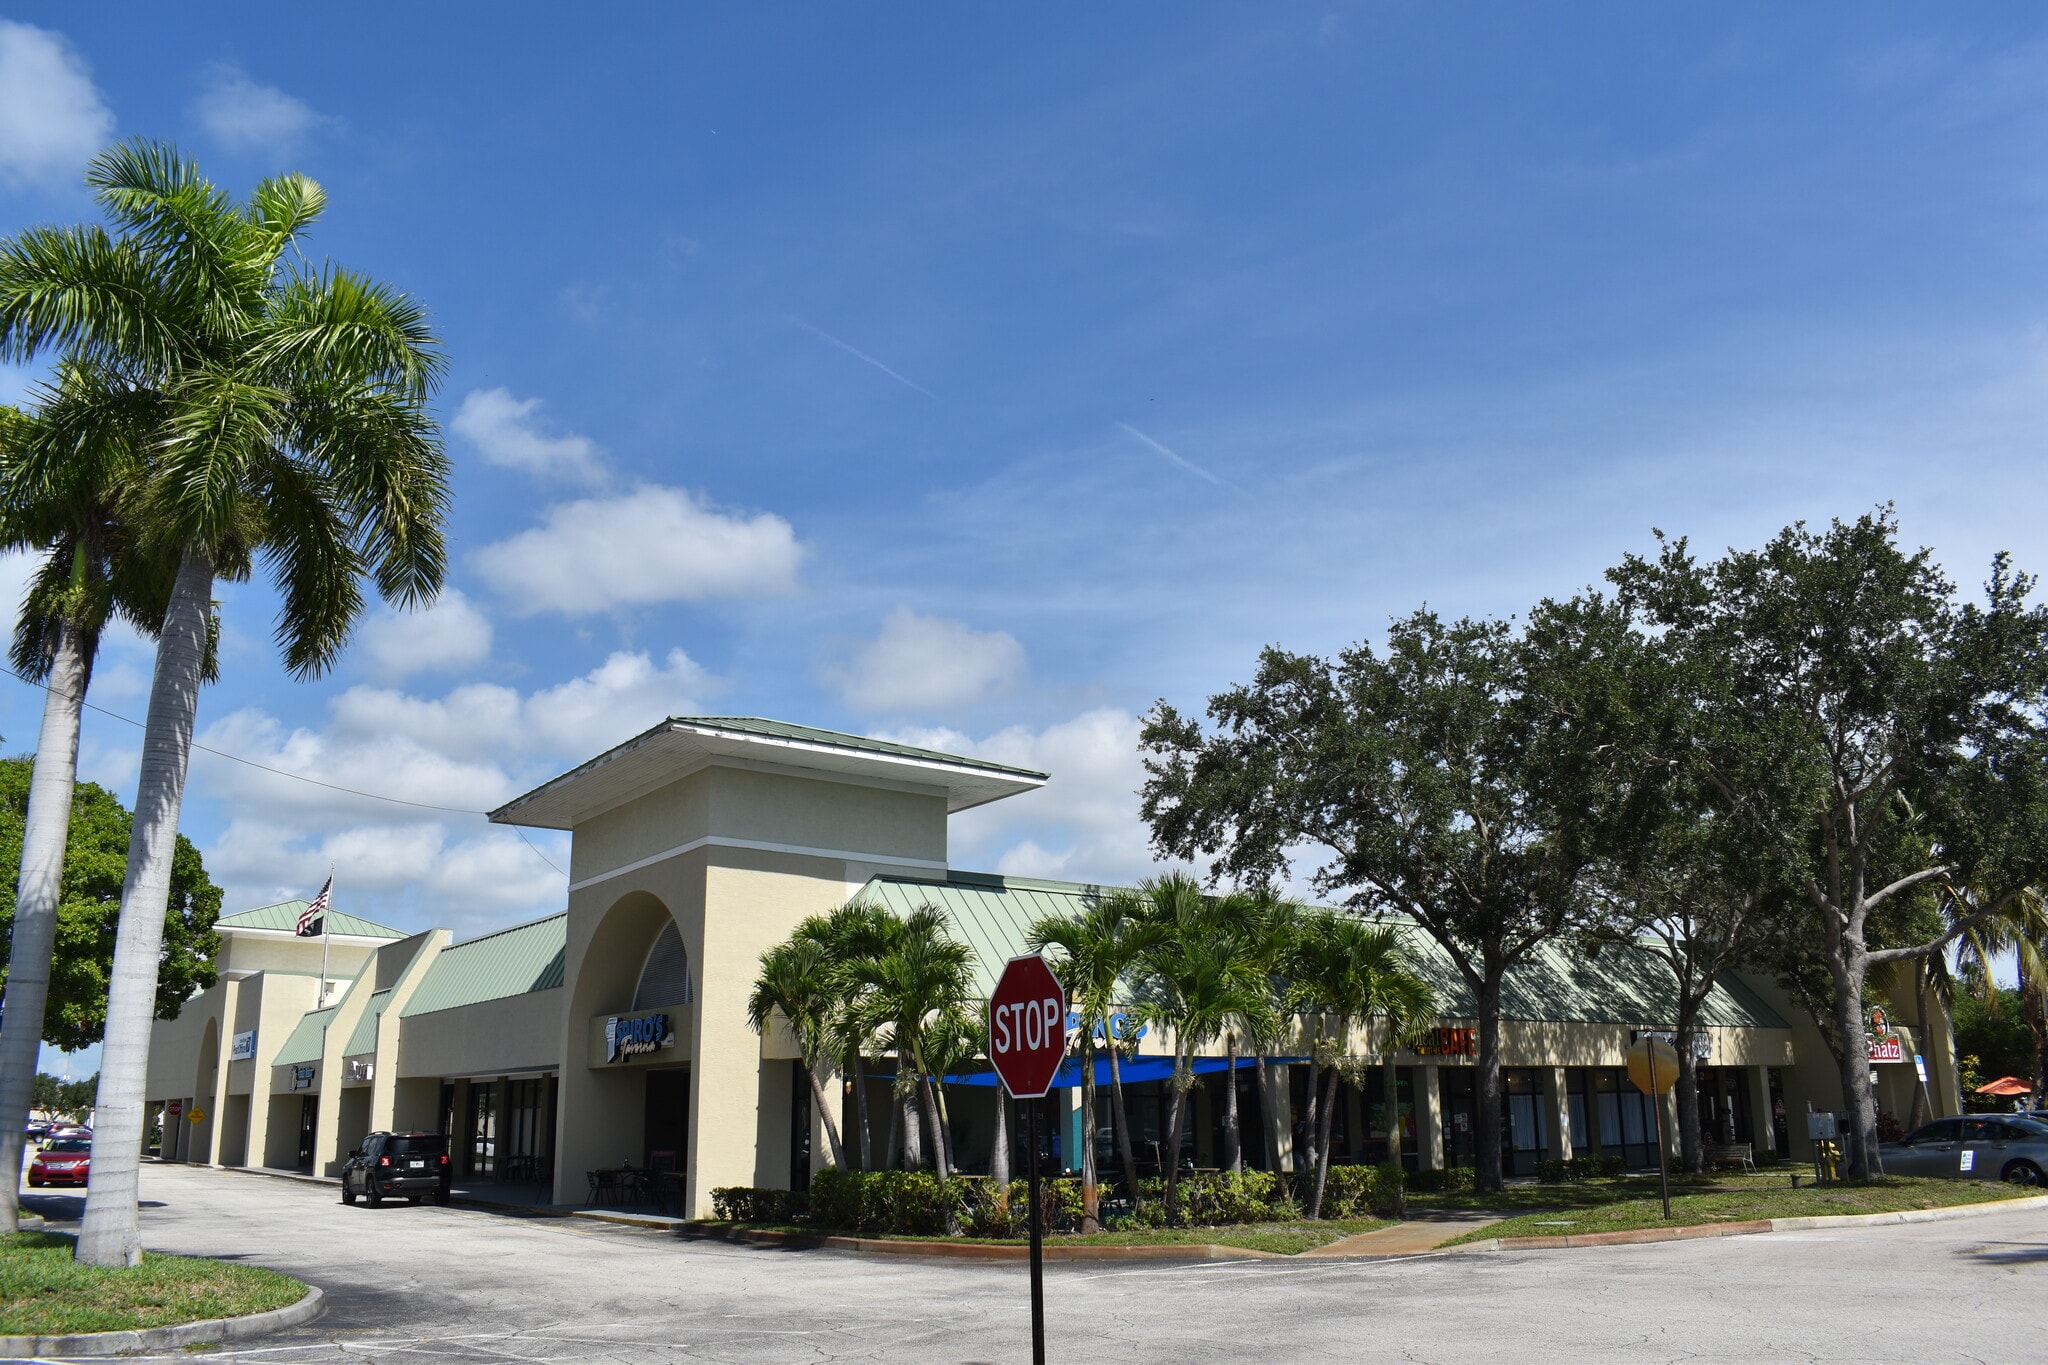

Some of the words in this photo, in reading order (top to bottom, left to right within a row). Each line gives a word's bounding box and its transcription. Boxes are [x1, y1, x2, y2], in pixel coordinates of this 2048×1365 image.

[616, 1014, 664, 1046] SPIRO'S
[995, 997, 1059, 1054] STOP
[1439, 1027, 1477, 1056] CAFE
